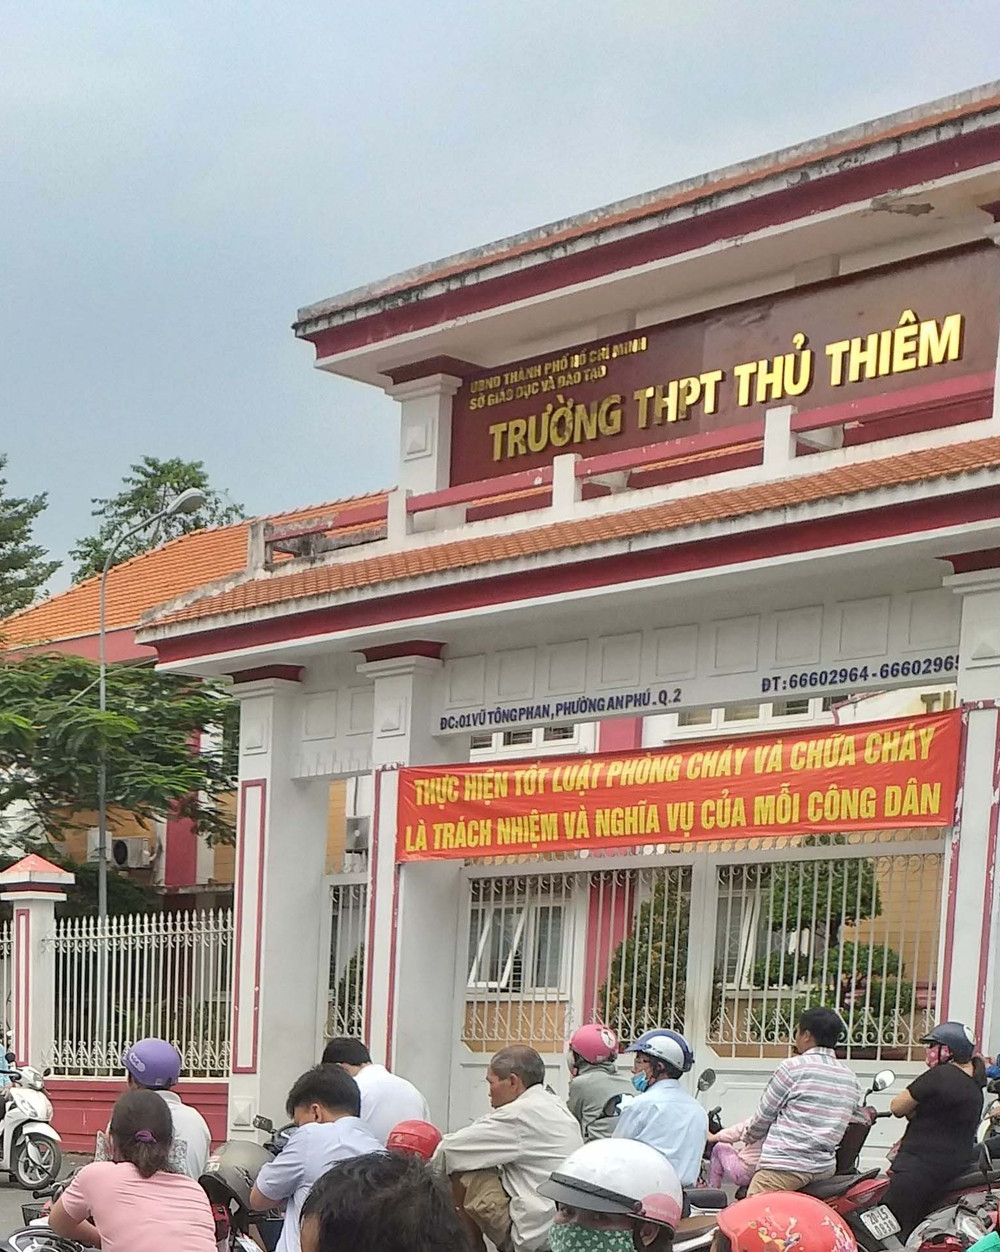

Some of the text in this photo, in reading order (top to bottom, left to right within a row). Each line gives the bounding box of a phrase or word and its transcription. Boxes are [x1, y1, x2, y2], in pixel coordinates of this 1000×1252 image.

[470, 375, 501, 394] UBND
[612, 336, 648, 359] MINH
[488, 308, 964, 461] TRƯỜNG THPT THỦ THIÊM
[541, 375, 556, 392] VÀ
[414, 722, 936, 810] THỰC HIỆN TỐT LUẬT PHÒNG CHÁY VÀ CHỮA CHÁY
[405, 776, 942, 852] LÀ TRÁCH NHIỆM VÀ NGHĨA VỤ CỦA MỖI CÔNG DÂN
